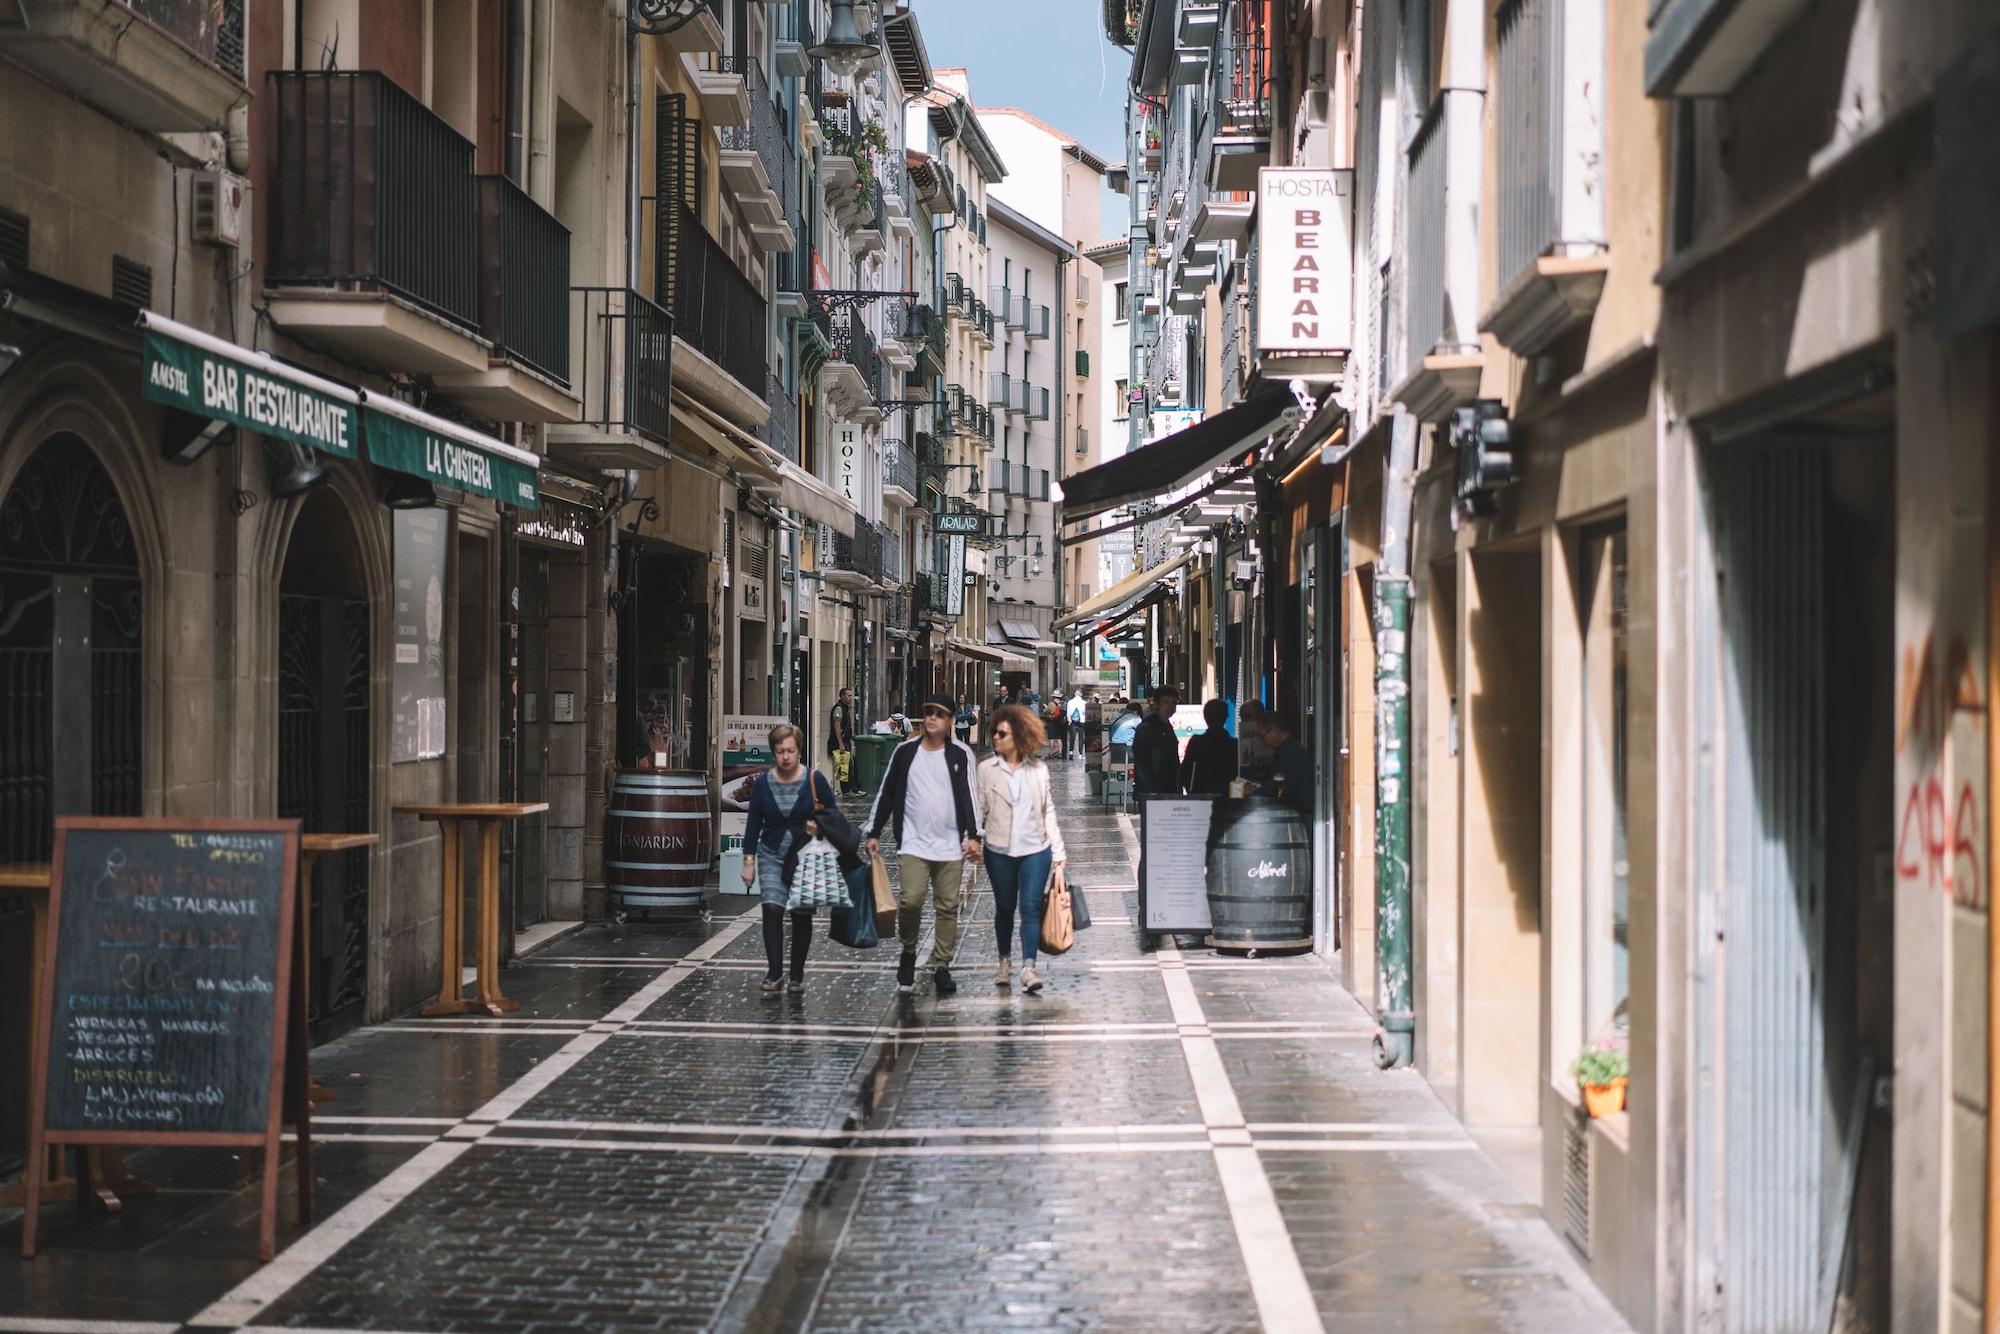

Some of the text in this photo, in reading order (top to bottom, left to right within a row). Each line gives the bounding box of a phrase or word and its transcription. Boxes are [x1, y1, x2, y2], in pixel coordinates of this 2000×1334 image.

[1267, 178, 1347, 197] HOSTAL
[1292, 209, 1321, 338] BEARAN
[150, 359, 349, 449] AMSTEL BAR RESTAURANTE
[426, 436, 443, 475] LA
[443, 442, 492, 490] CHISTERA
[841, 430, 854, 499] HOSTA
[940, 516, 978, 530] ARALAR
[952, 535, 961, 613] RESTAURANTE
[749, 722, 756, 730] VA
[134, 896, 257, 915] RESTAURANTE
[160, 1019, 230, 1035] NAVARRAS
